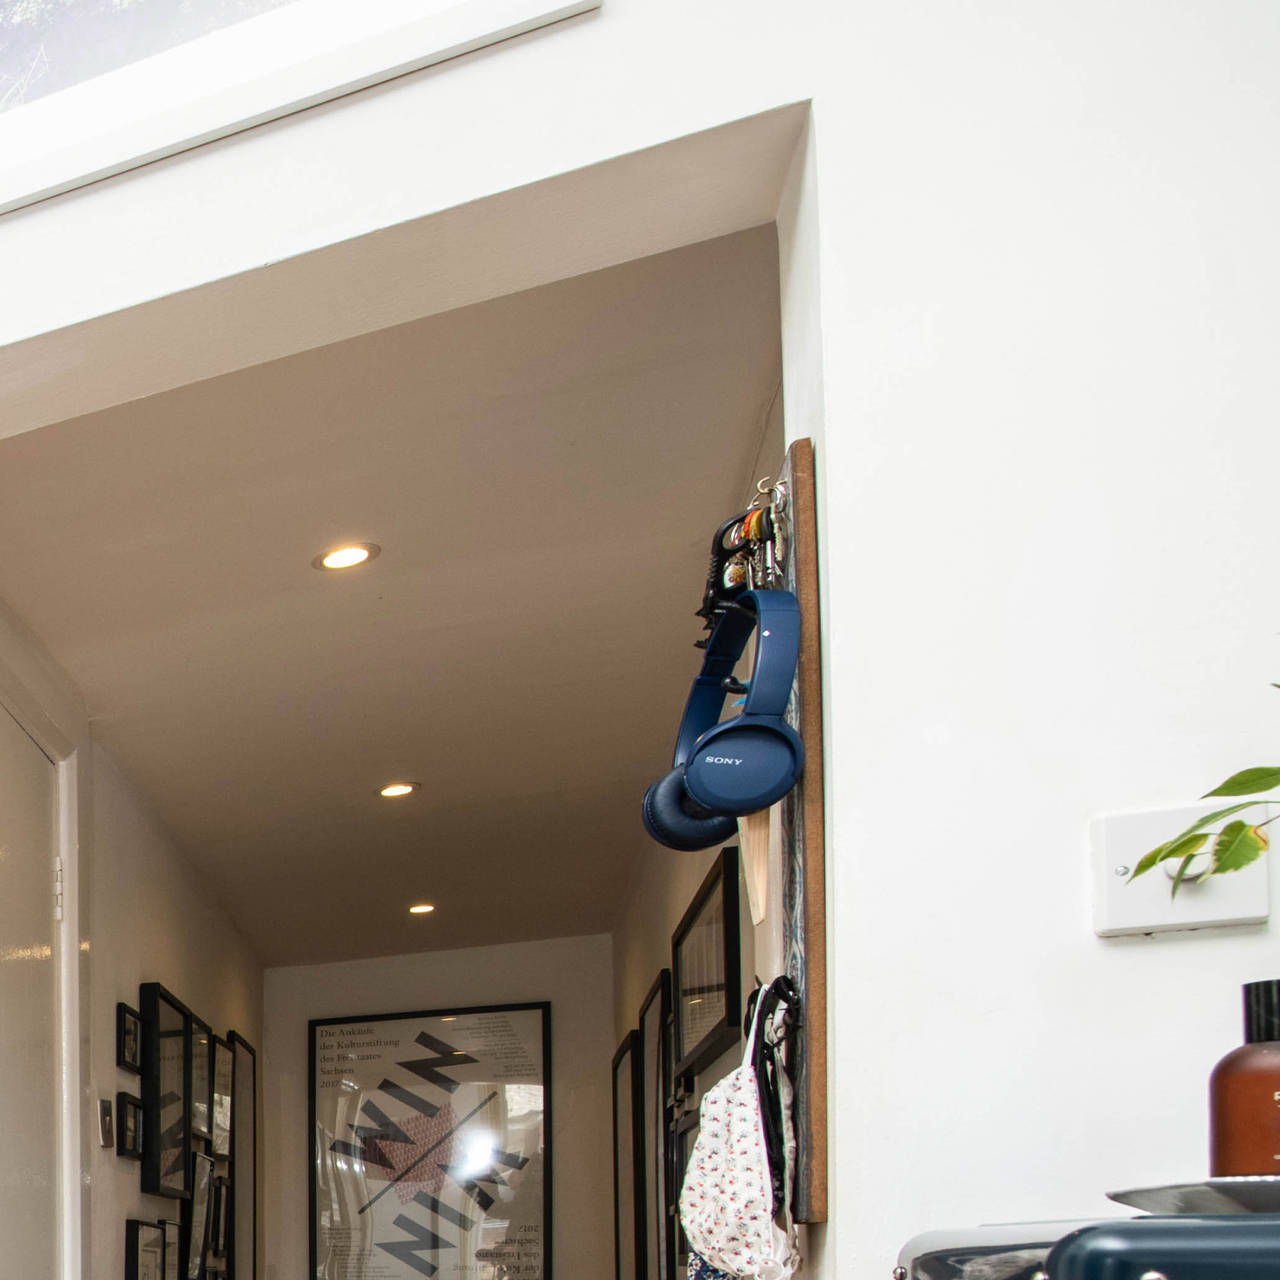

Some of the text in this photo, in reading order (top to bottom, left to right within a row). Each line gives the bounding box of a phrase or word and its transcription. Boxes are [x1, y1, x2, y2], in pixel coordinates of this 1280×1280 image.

[705, 756, 743, 766] SONY
[320, 1029, 336, 1038] Die
[320, 1042, 334, 1050] der
[320, 1055, 334, 1063] des
[320, 1067, 354, 1075] Sachsen
